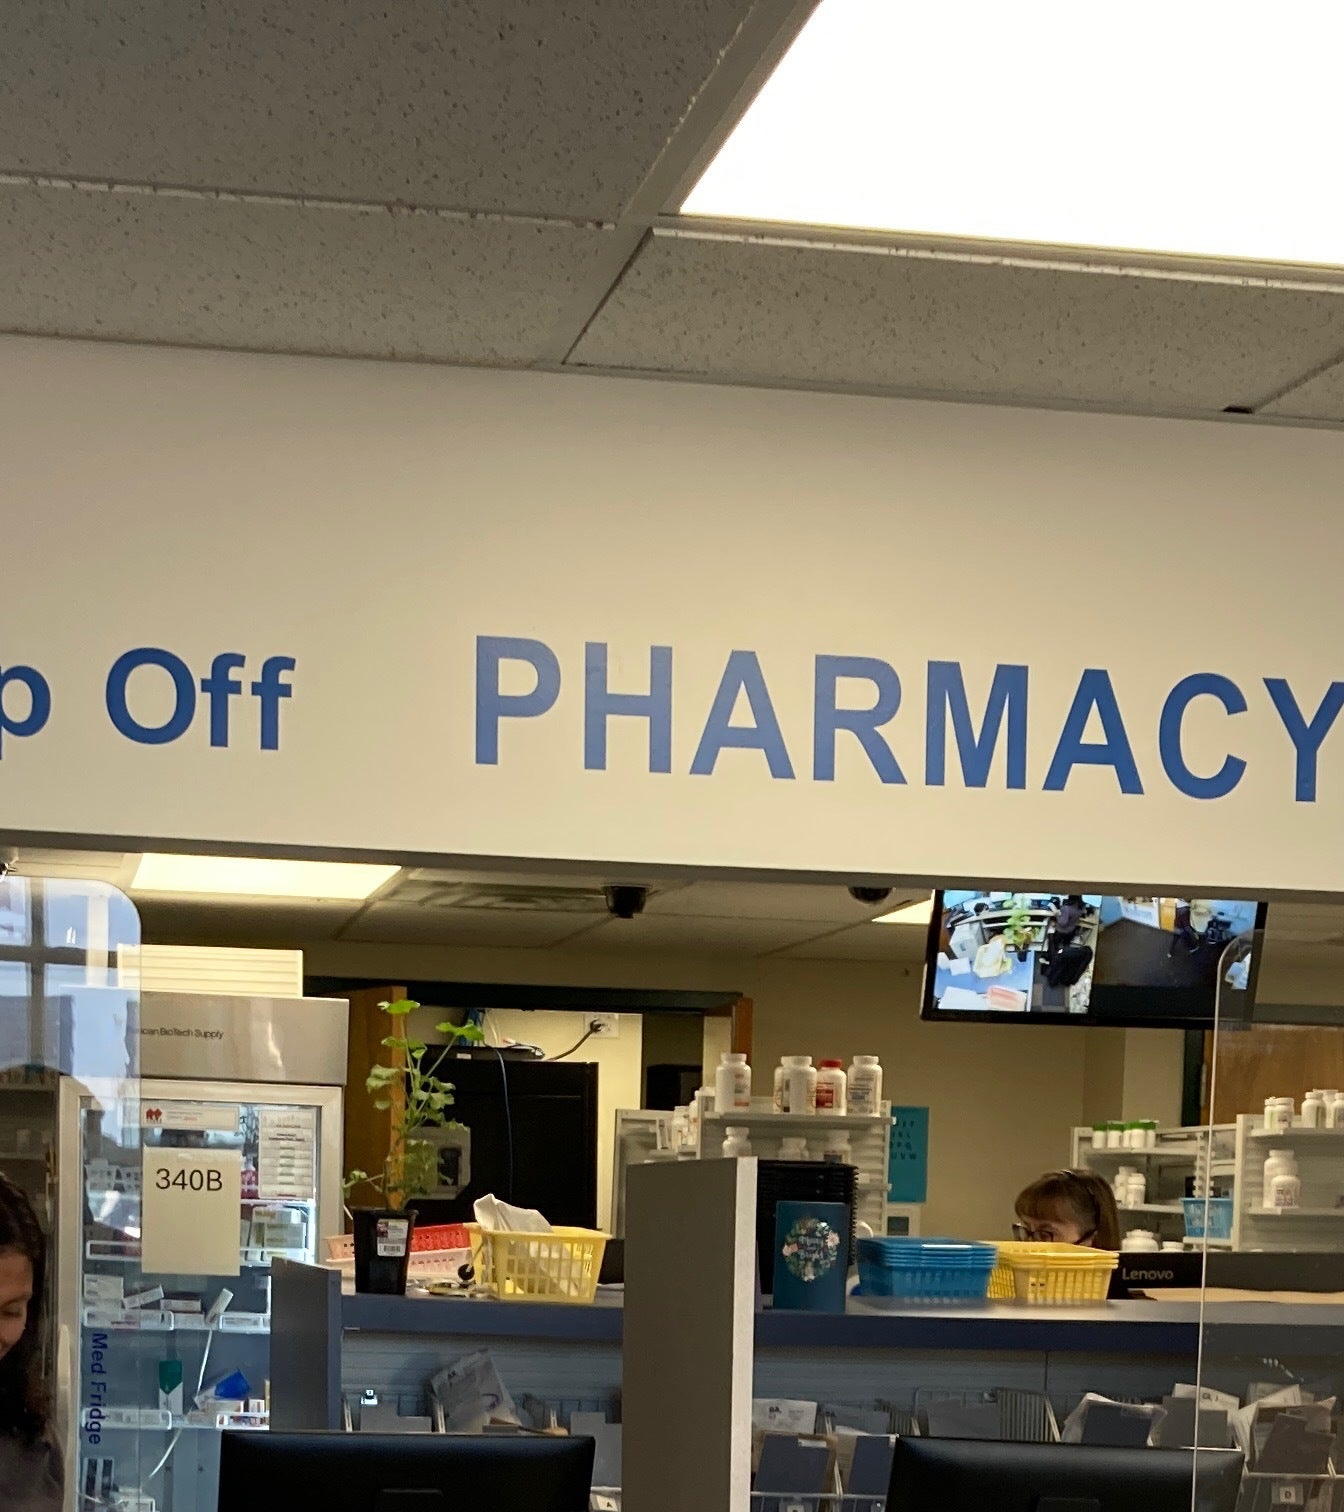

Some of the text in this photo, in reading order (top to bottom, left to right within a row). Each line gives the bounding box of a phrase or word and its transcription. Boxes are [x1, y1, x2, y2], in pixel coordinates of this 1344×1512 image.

[106, 648, 294, 750] Off
[194, 1029, 224, 1040] Supply
[155, 1168, 223, 1191] 340B
[1122, 1267, 1175, 1281] Lenovo
[85, 1333, 108, 1445] Med Fridge
